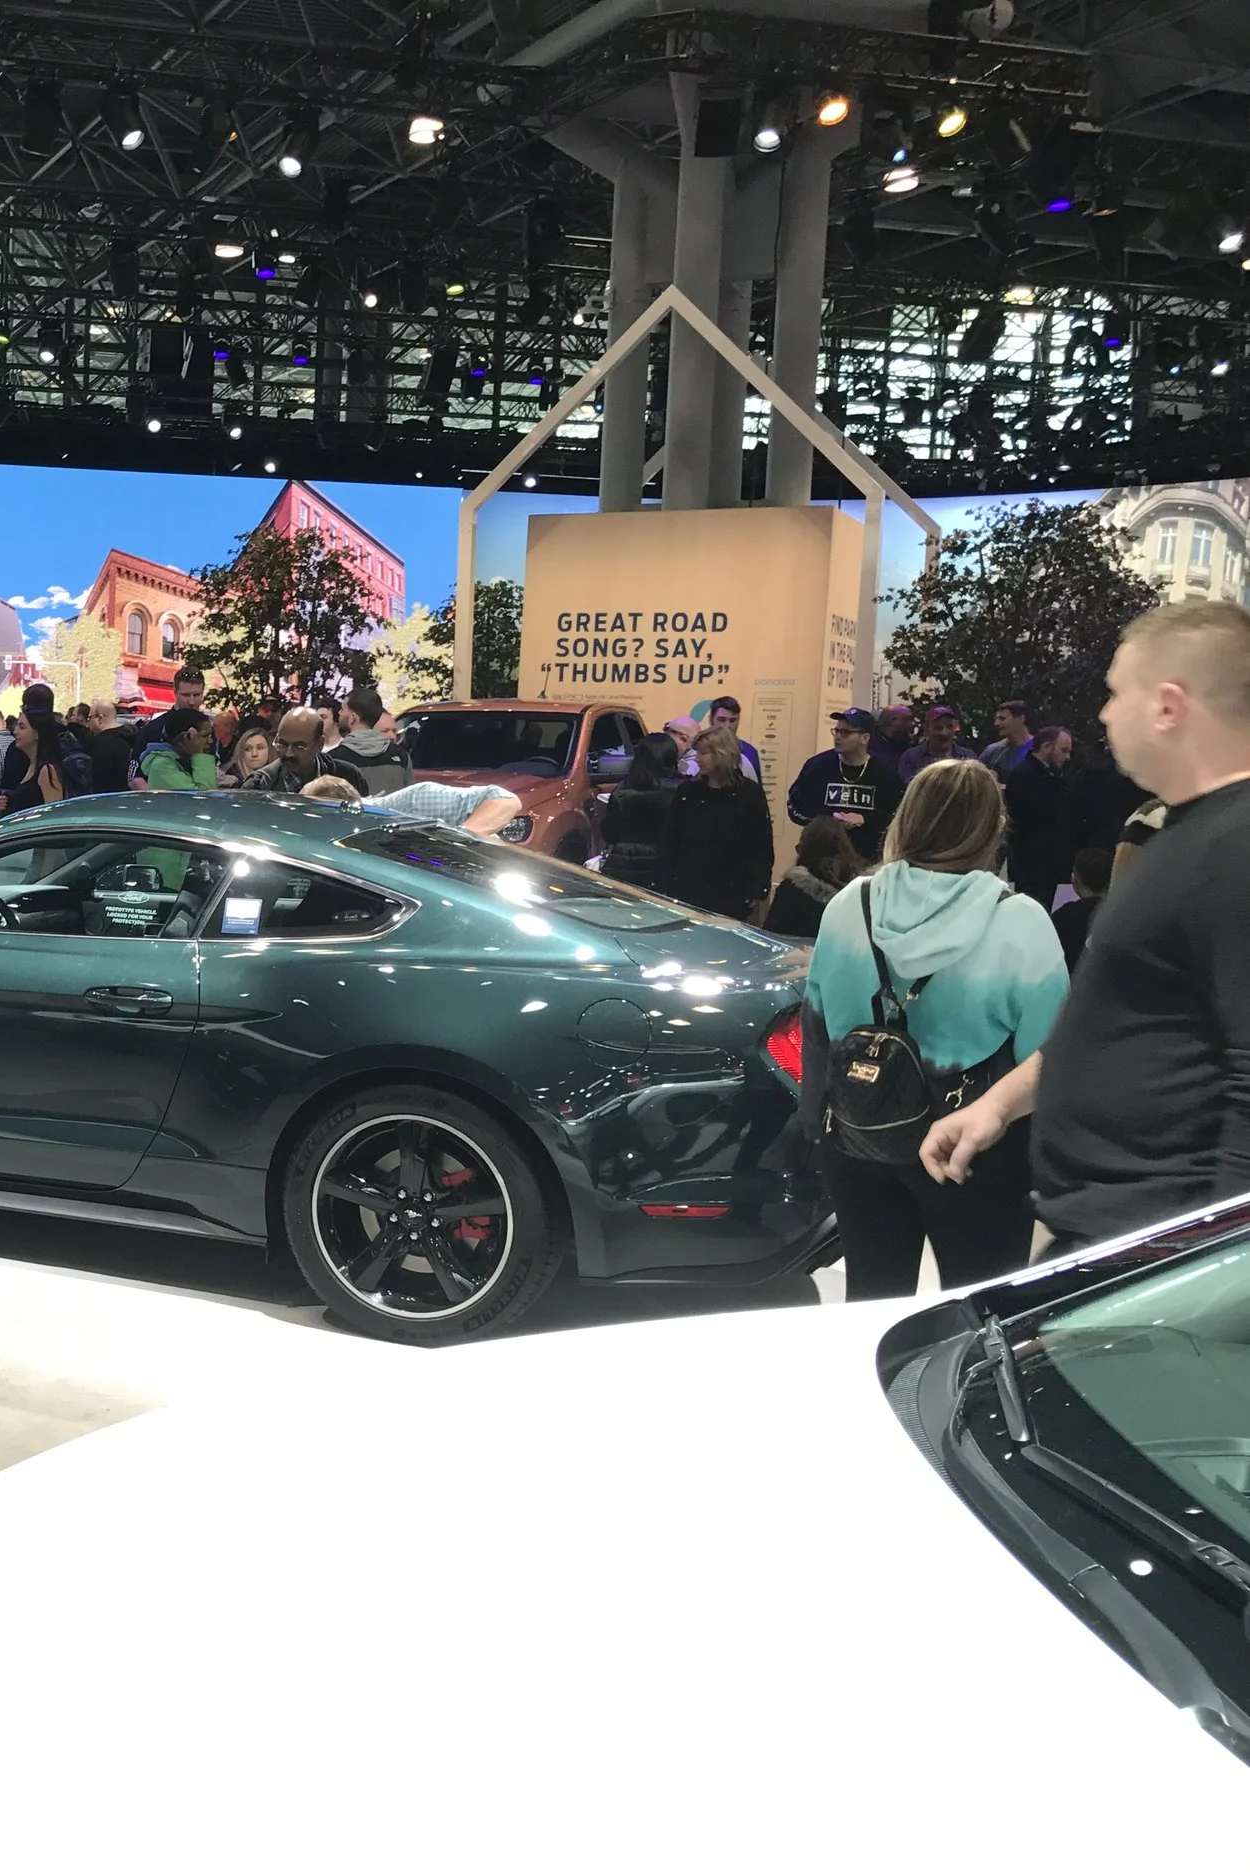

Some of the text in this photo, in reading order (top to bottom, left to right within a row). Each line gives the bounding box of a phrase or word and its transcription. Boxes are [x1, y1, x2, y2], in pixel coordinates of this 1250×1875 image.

[557, 612, 728, 632] GREAT ROAD
[555, 638, 712, 662] SONG? SAY,
[829, 789, 870, 804] vein
